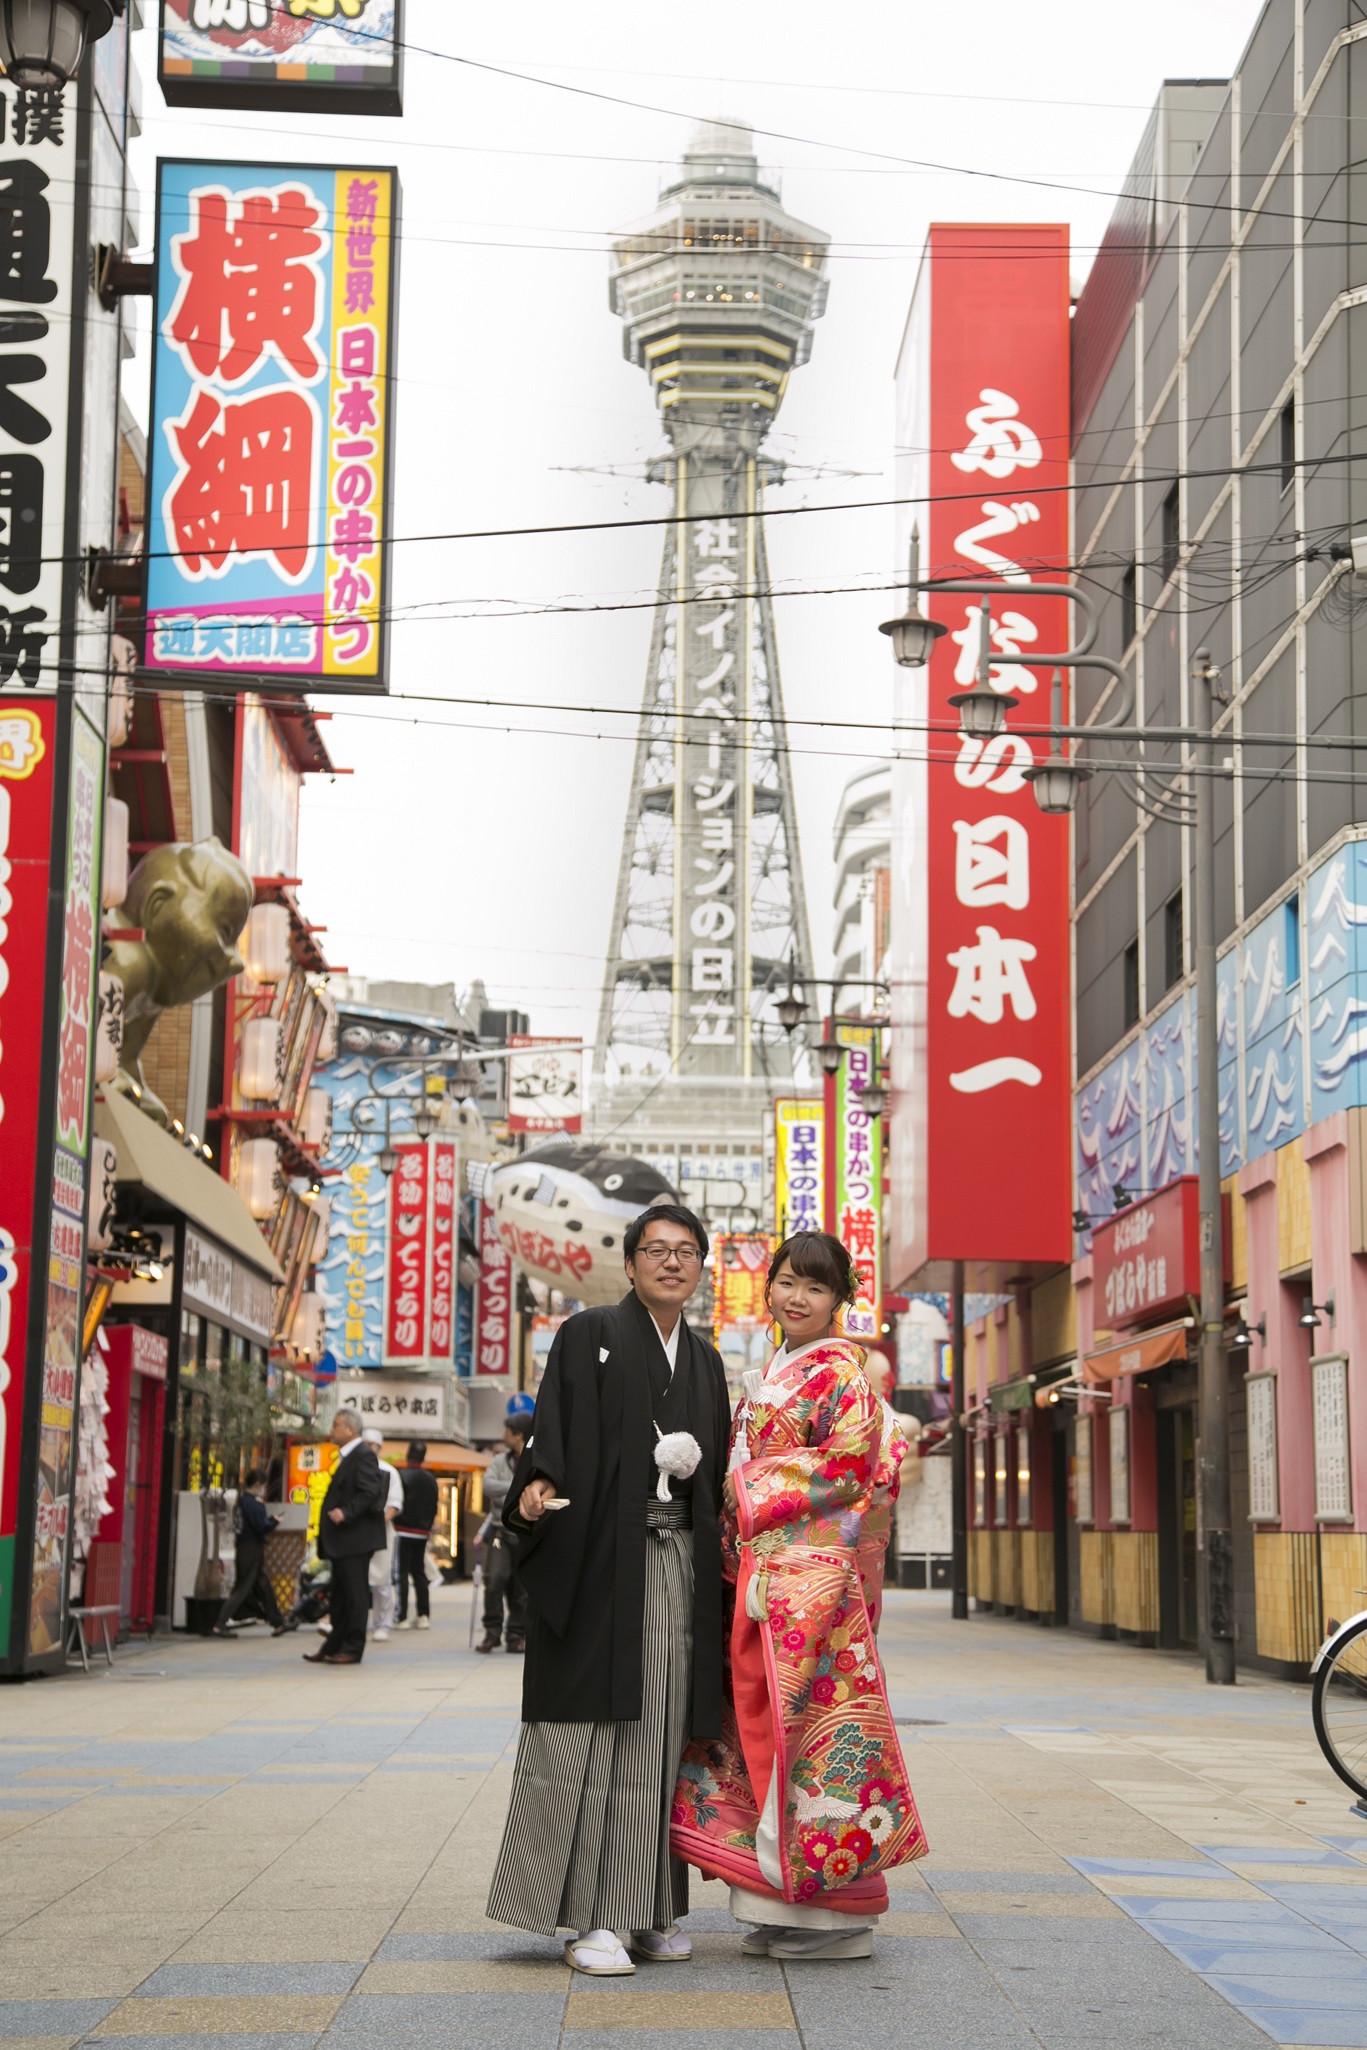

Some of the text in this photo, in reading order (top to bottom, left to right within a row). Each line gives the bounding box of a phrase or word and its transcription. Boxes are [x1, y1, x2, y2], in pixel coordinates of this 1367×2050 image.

[168, 188, 325, 582] 横綱
[333, 179, 381, 662] 新世界 日本一の串かつ
[155, 615, 315, 662] 通天閣店
[690, 520, 738, 1046] 社会イノベーションの日立
[394, 1153, 423, 1348] 名物 てっちり
[431, 1154, 454, 1348] 名物 てっちり
[499, 1221, 593, 1282] づぼらや
